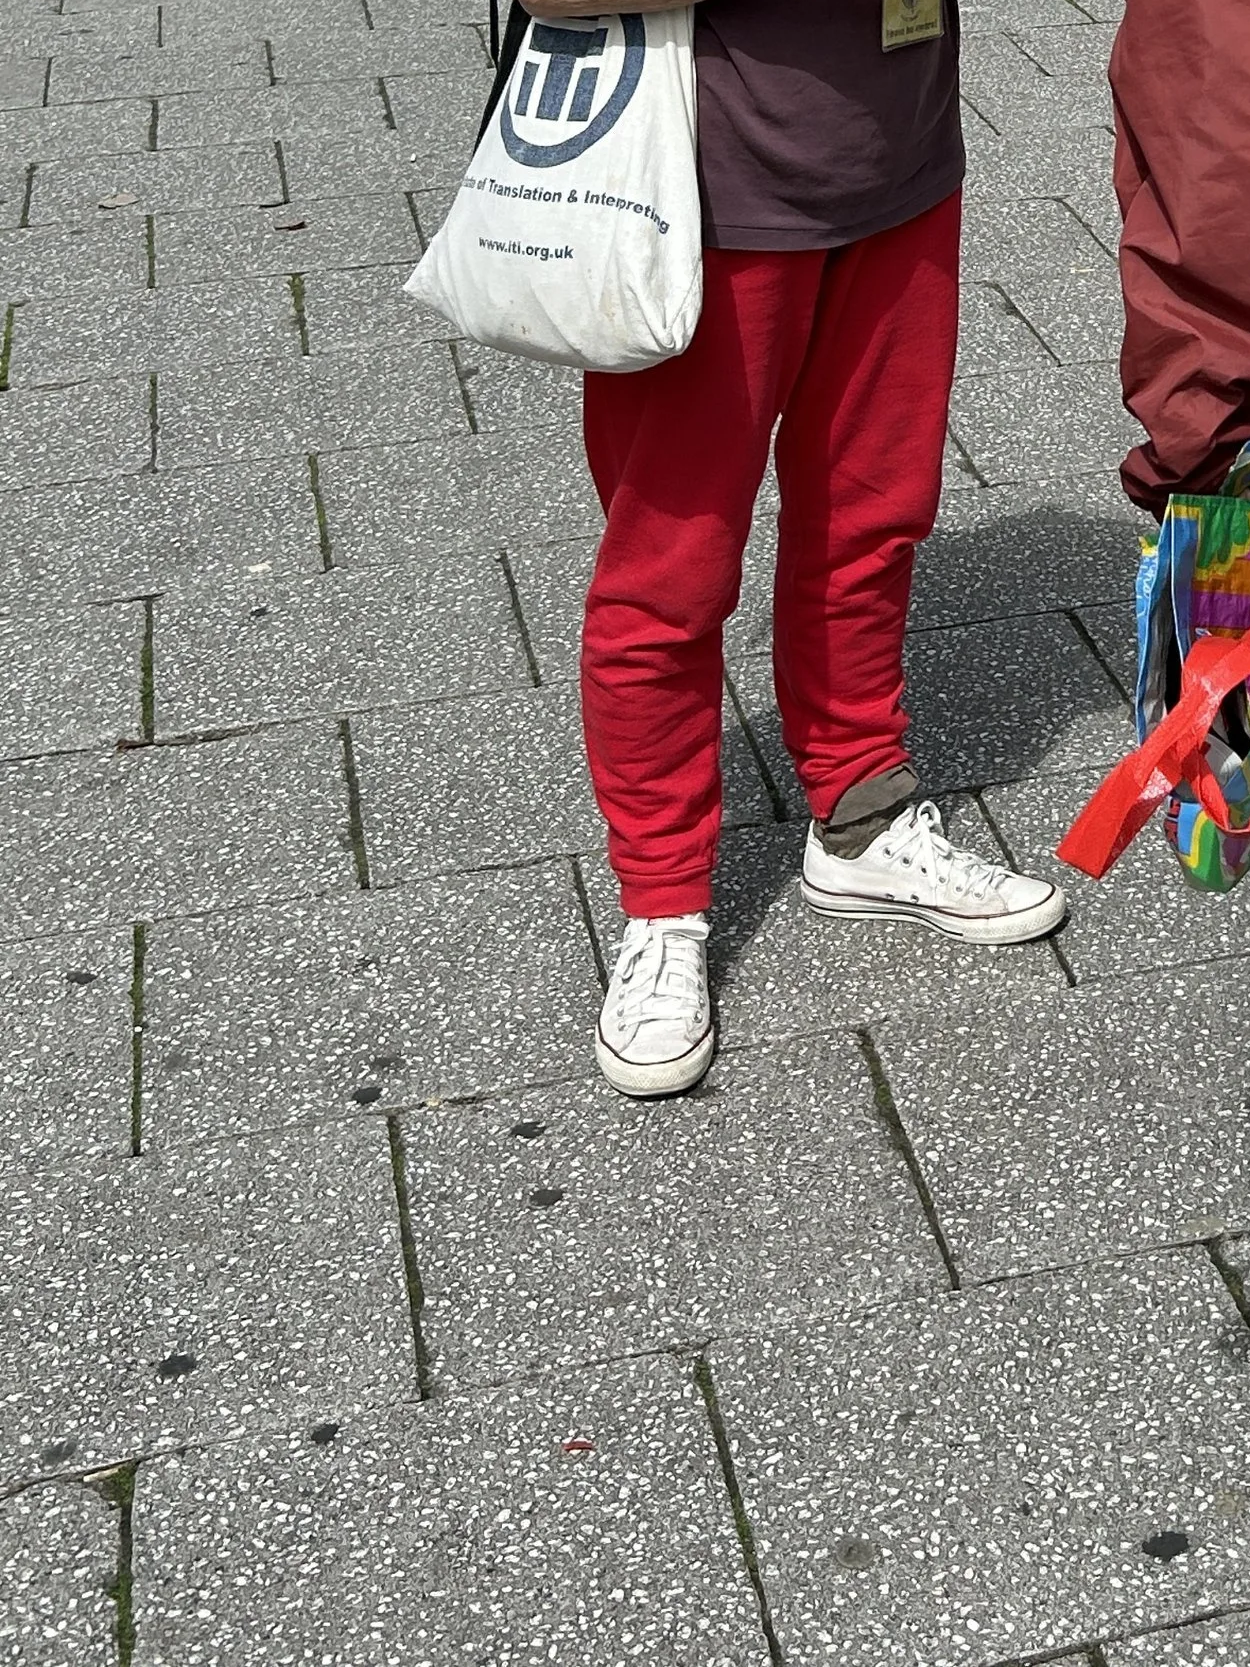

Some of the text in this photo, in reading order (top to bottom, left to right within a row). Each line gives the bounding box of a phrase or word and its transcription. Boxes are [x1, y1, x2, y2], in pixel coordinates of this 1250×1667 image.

[489, 179, 562, 203] Translation
[567, 189, 578, 203] &
[479, 237, 574, 261] www.iti.org.uk
